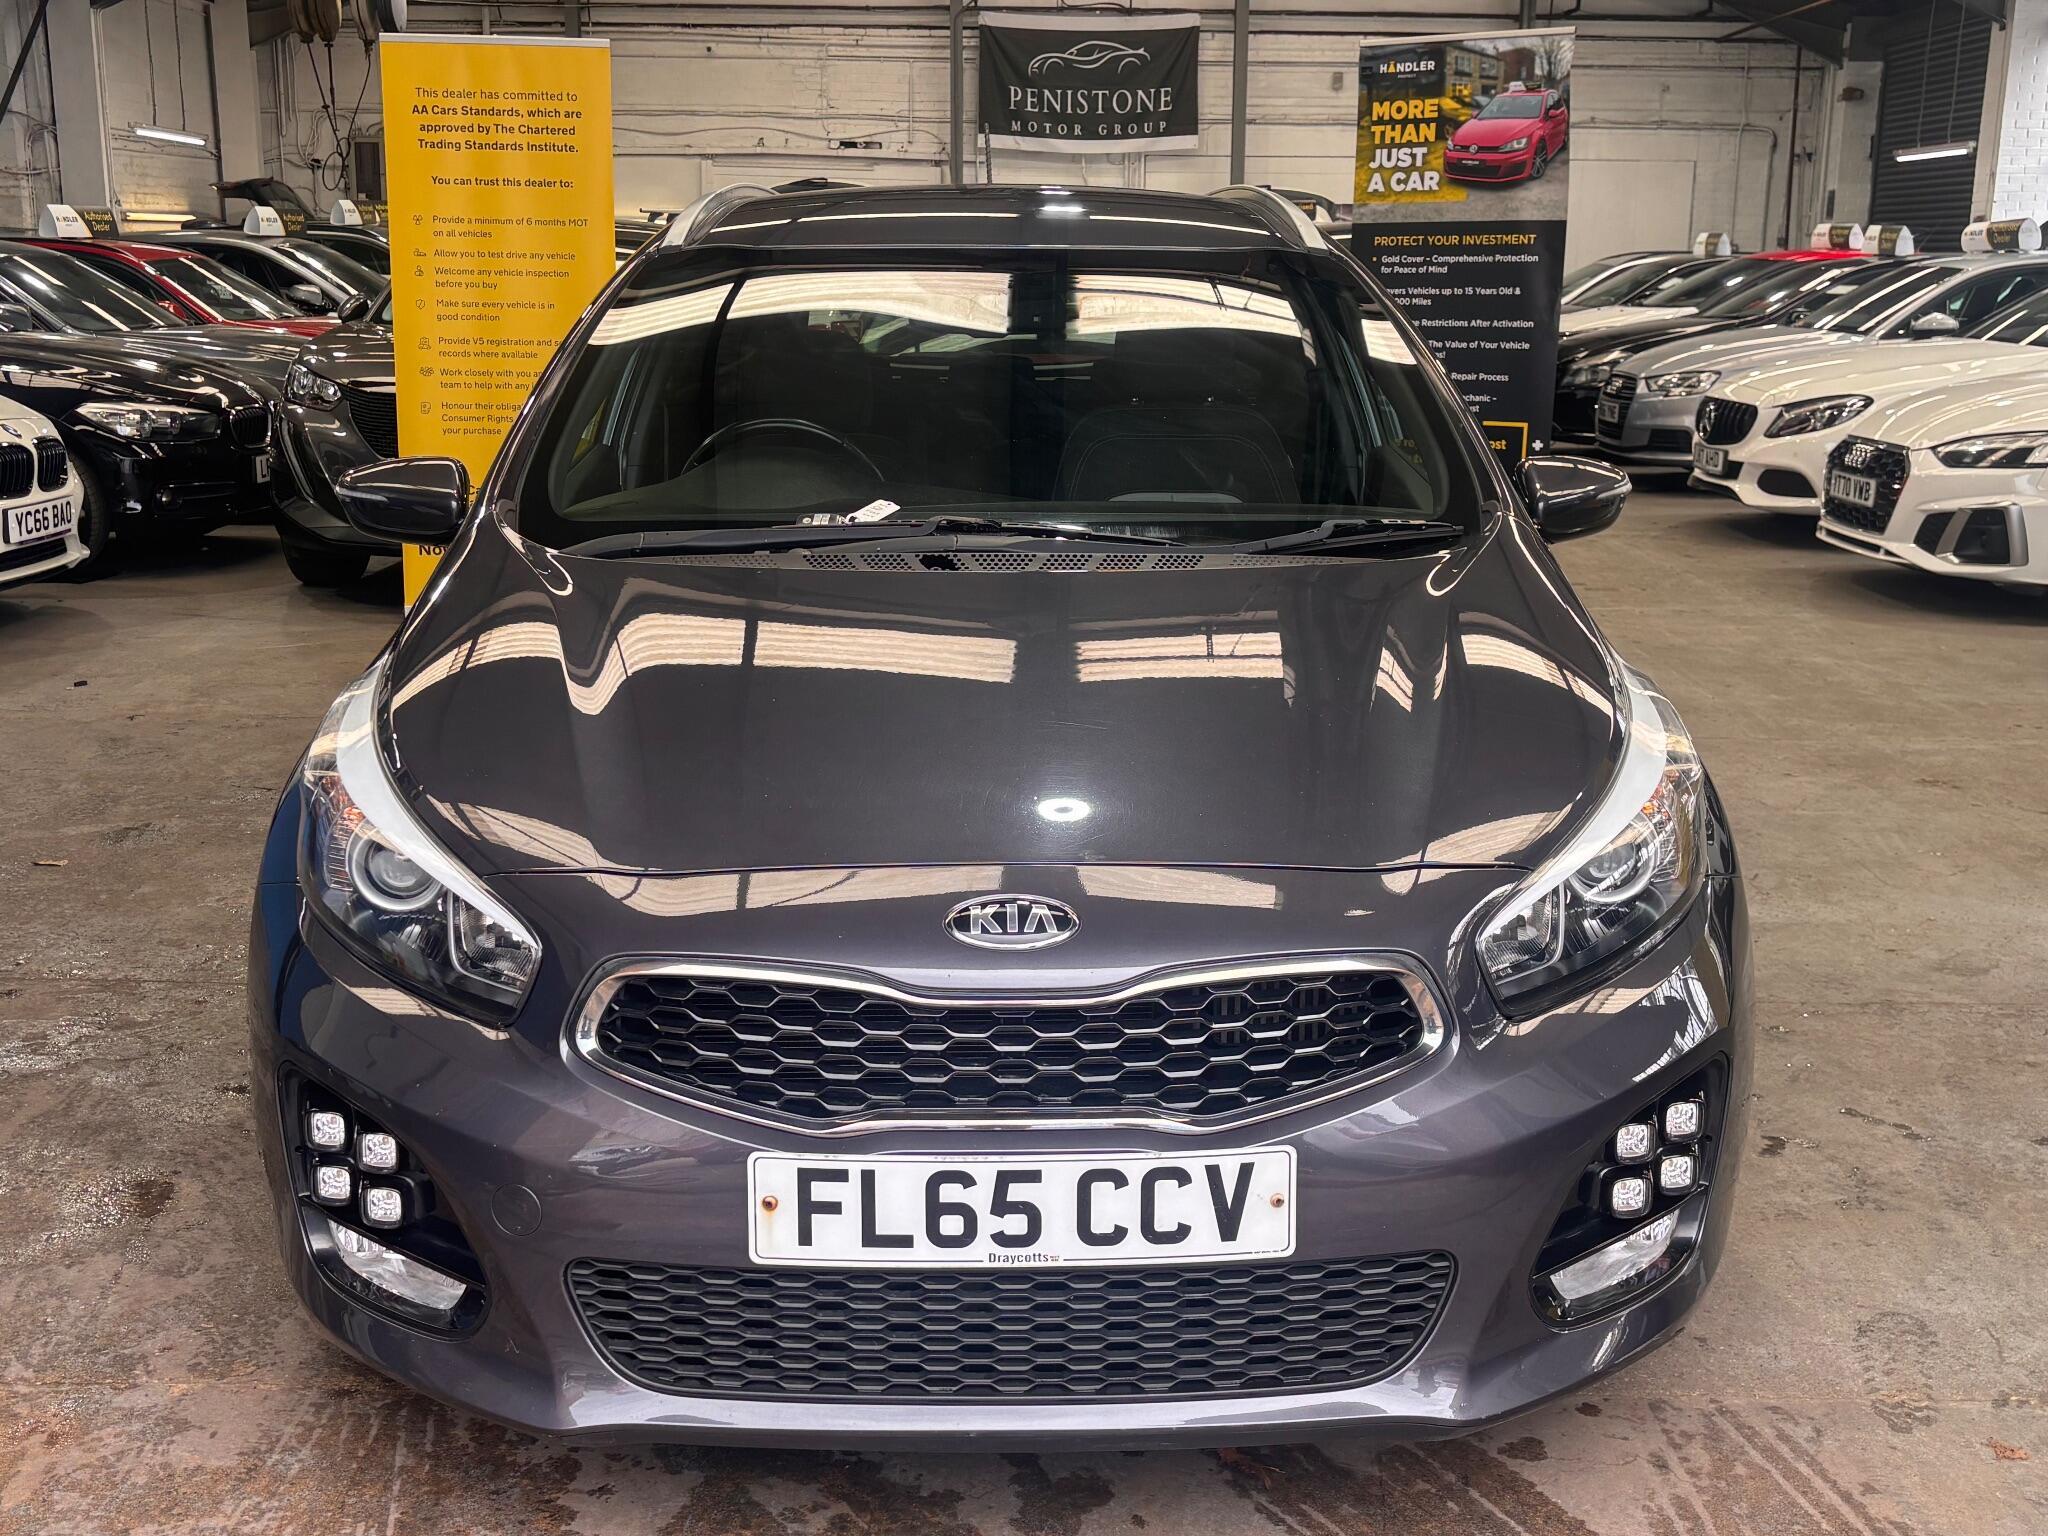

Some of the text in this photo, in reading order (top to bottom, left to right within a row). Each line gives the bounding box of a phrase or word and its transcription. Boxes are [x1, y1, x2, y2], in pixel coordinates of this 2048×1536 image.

[415, 87, 577, 101] This dealer has committed to
[1008, 86, 1173, 114] PENISTONE
[412, 105, 582, 119] AA Cars Standards, which are
[1372, 99, 1439, 121] MORE
[419, 124, 575, 135] approved by The Chartered
[1011, 120, 1167, 135] MOTOR GROUP
[1371, 123, 1436, 144] THAN
[418, 139, 578, 153] Trading Standards Institute.
[1369, 147, 1427, 168] JUST
[431, 176, 573, 188] You can trust this dealer to:
[1367, 171, 1440, 192] A CAR
[432, 216, 465, 225] Provide
[475, 217, 512, 225] minimum
[516, 217, 524, 225] of
[526, 217, 532, 226] 6
[534, 218, 566, 226] months
[569, 219, 588, 227] MOT
[446, 229, 456, 237] all
[458, 229, 492, 238] vehicles
[1375, 235, 1536, 246] PROTECT YOUR INVESTMENT
[434, 250, 575, 261] Allow you to test drive any vehicle
[1382, 255, 1399, 263] Gold
[1401, 255, 1424, 263] Cover
[1432, 255, 1493, 264] Comprehensive
[435, 267, 569, 278] Welcome any vehicle inspection
[1394, 266, 1416, 274] Peace
[435, 280, 497, 290] before you buy
[1408, 287, 1440, 295] Vehicles
[1442, 288, 1452, 296] up
[1465, 287, 1473, 295] 15
[1475, 287, 1497, 295] Years
[1499, 287, 1512, 295] Old
[1514, 287, 1520, 295] &
[437, 300, 459, 308] Make
[482, 301, 504, 310] every
[506, 301, 535, 309] vehicle
[538, 301, 545, 309] is
[547, 301, 554, 309] in
[437, 313, 499, 322] good condition
[1492, 320, 1534, 328] Activation
[438, 337, 470, 345] Provide
[473, 337, 484, 345] V5
[487, 338, 535, 347] registration
[537, 338, 552, 346] and
[1470, 341, 1478, 349] of
[1480, 341, 1498, 349] Your
[1500, 341, 1530, 349] Vehicle
[439, 350, 538, 359] records where available
[440, 368, 462, 376] Work
[464, 369, 494, 379] closely
[496, 369, 513, 377] with
[516, 371, 531, 379] you
[1452, 373, 1509, 382] Repair Process
[463, 381, 472, 390] to
[475, 381, 493, 391] help
[495, 381, 512, 390] with
[515, 383, 530, 391] any
[441, 402, 475, 410] Honour
[478, 402, 494, 411] their
[442, 414, 513, 424] Consumer Rights
[442, 427, 501, 436] your purchase
[15, 501, 71, 536] YC66 BAO
[969, 904, 1058, 934] KIA
[797, 1162, 1255, 1249] FL65 CCV
[989, 1252, 1048, 1264] Draycotts
